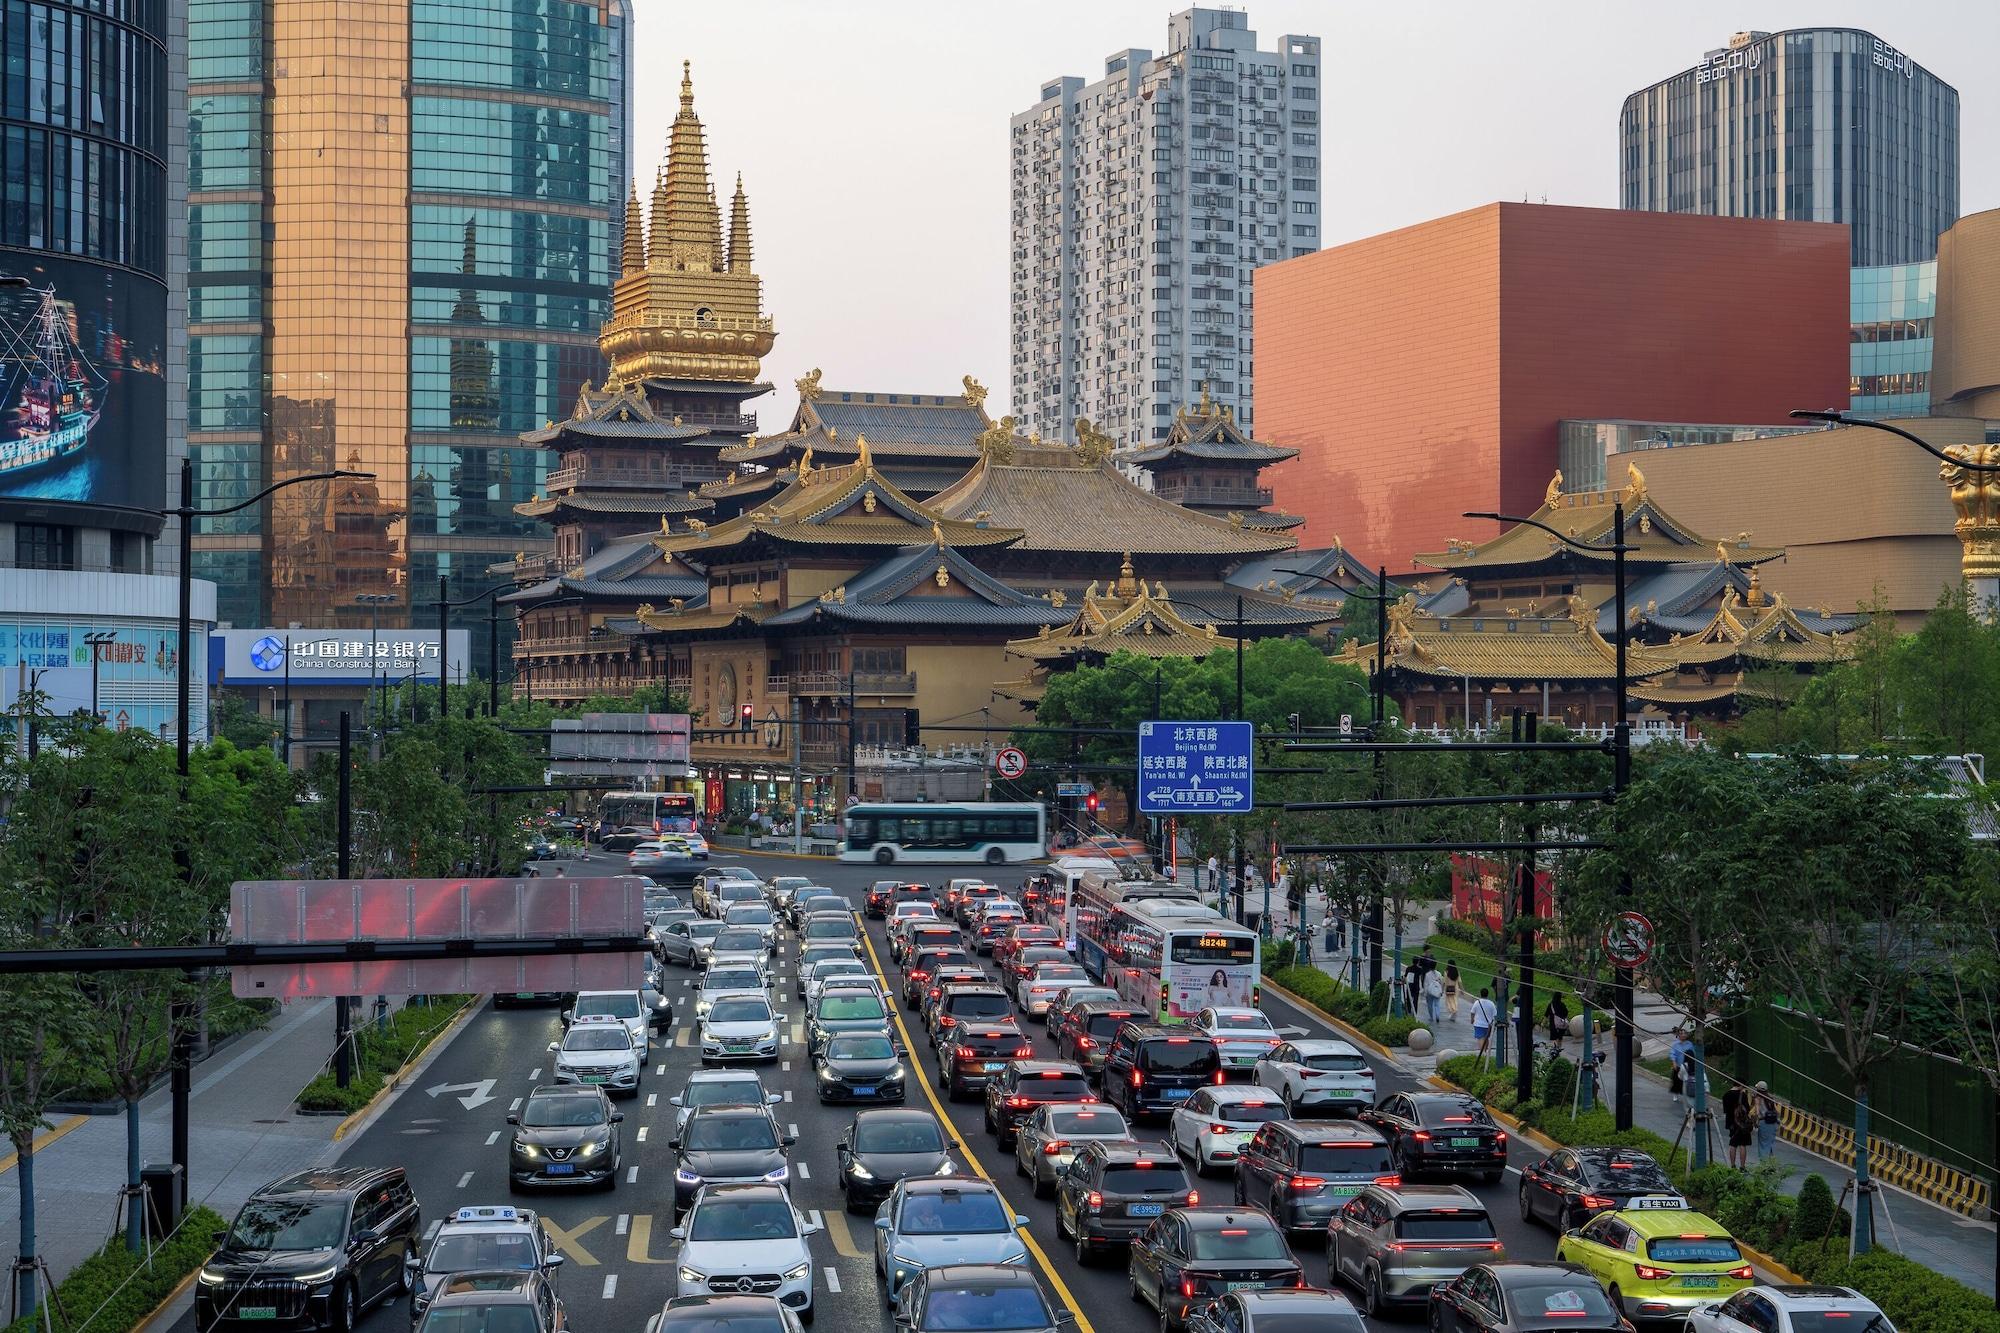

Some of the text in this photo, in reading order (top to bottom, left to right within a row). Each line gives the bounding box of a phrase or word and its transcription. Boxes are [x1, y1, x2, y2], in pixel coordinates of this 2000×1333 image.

[293, 641, 441, 658] 中国建设银行
[293, 659, 421, 669] China Construcion Bank
[1173, 727, 1218, 741] 北京西路
[1175, 743, 1198, 752] Beijing
[1143, 755, 1187, 769] 延安西路
[1203, 755, 1249, 769] 陕西北路
[1204, 771, 1230, 779] Shaanxi
[1176, 791, 1215, 802] 南京西路
